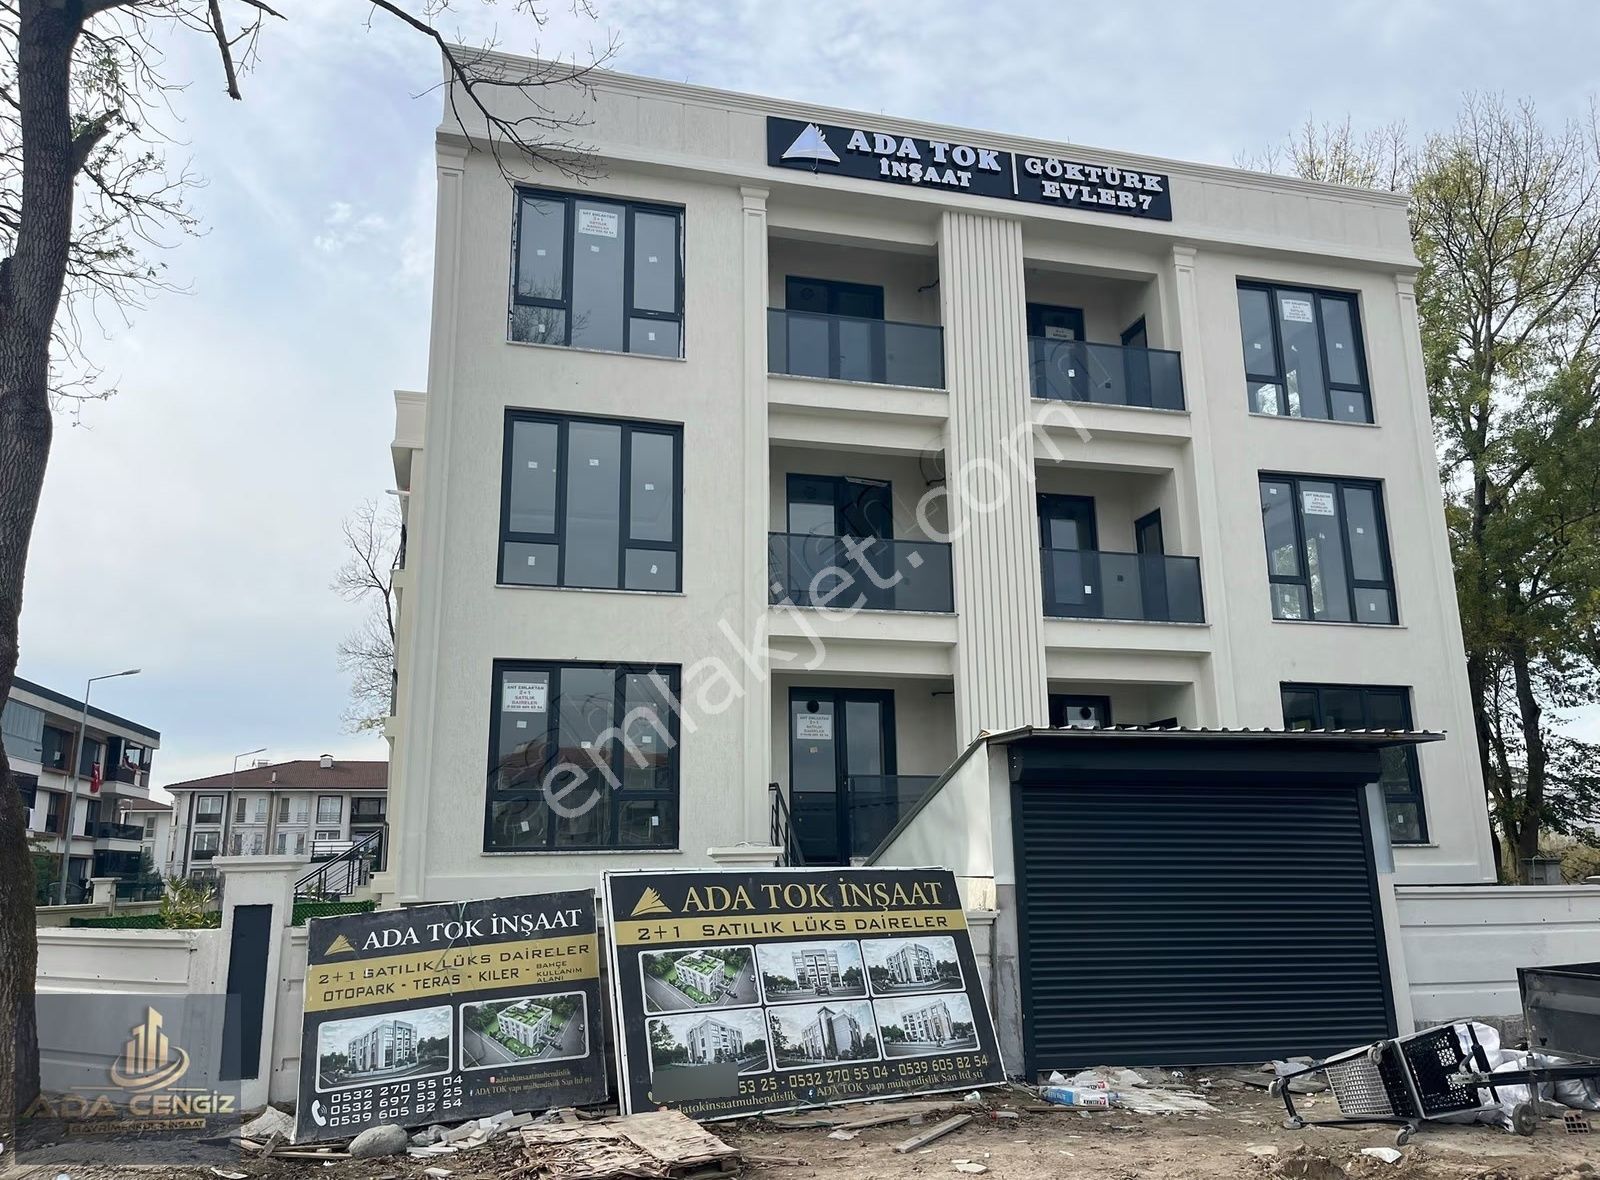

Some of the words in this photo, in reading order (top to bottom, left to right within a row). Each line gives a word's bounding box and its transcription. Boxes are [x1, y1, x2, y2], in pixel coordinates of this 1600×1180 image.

[847, 130, 921, 160] ADA
[929, 140, 1002, 171] TOK
[879, 157, 972, 187] İNŞAAT
[1024, 155, 1163, 192] GÖKTÜRK
[681, 885, 756, 913] ADA
[760, 883, 833, 909] TOK
[837, 877, 942, 912] İNŞAAT
[362, 926, 420, 951] ADA
[426, 918, 484, 942] TOK
[491, 909, 582, 937] İNŞAAT
[638, 925, 680, 940] 2+1
[702, 921, 784, 936] SATILIK
[793, 916, 846, 932] LÜKS
[855, 914, 949, 930] DAİRELER
[363, 960, 434, 979] SATILIK
[442, 954, 491, 969] LÜKS
[500, 944, 590, 962] DAİRELER
[536, 960, 567, 970] BAHÇE
[537, 967, 582, 977] KULLANIM
[324, 983, 395, 1002] OTOPARK
[413, 974, 460, 990] TERAS
[537, 975, 564, 983] ALANI
[739, 1079, 756, 1094] 53
[760, 1077, 777, 1091] 25
[789, 1072, 822, 1088] 0532
[826, 1069, 850, 1083] 270
[853, 1066, 870, 1080] 55
[873, 1065, 889, 1078] 04
[898, 1061, 928, 1076] 0539
[932, 1058, 954, 1072] 605
[974, 1054, 989, 1068] 54
[816, 1086, 839, 1097] ADA
[842, 1082, 864, 1093] TOK
[942, 1071, 957, 1082] San
[330, 1101, 373, 1115] 0532
[379, 1095, 410, 1107] 697
[417, 1091, 436, 1102] 53
[444, 1086, 463, 1098] 25
[331, 1088, 373, 1103] 0532
[380, 1083, 411, 1096] 270
[417, 1079, 437, 1090] 55
[443, 1075, 463, 1086] 04
[475, 1088, 491, 1096] ADA
[492, 1085, 507, 1094] TOK
[330, 1112, 372, 1127] 0539
[379, 1106, 410, 1119] 605
[416, 1102, 436, 1113] 82
[443, 1098, 463, 1109] 54
